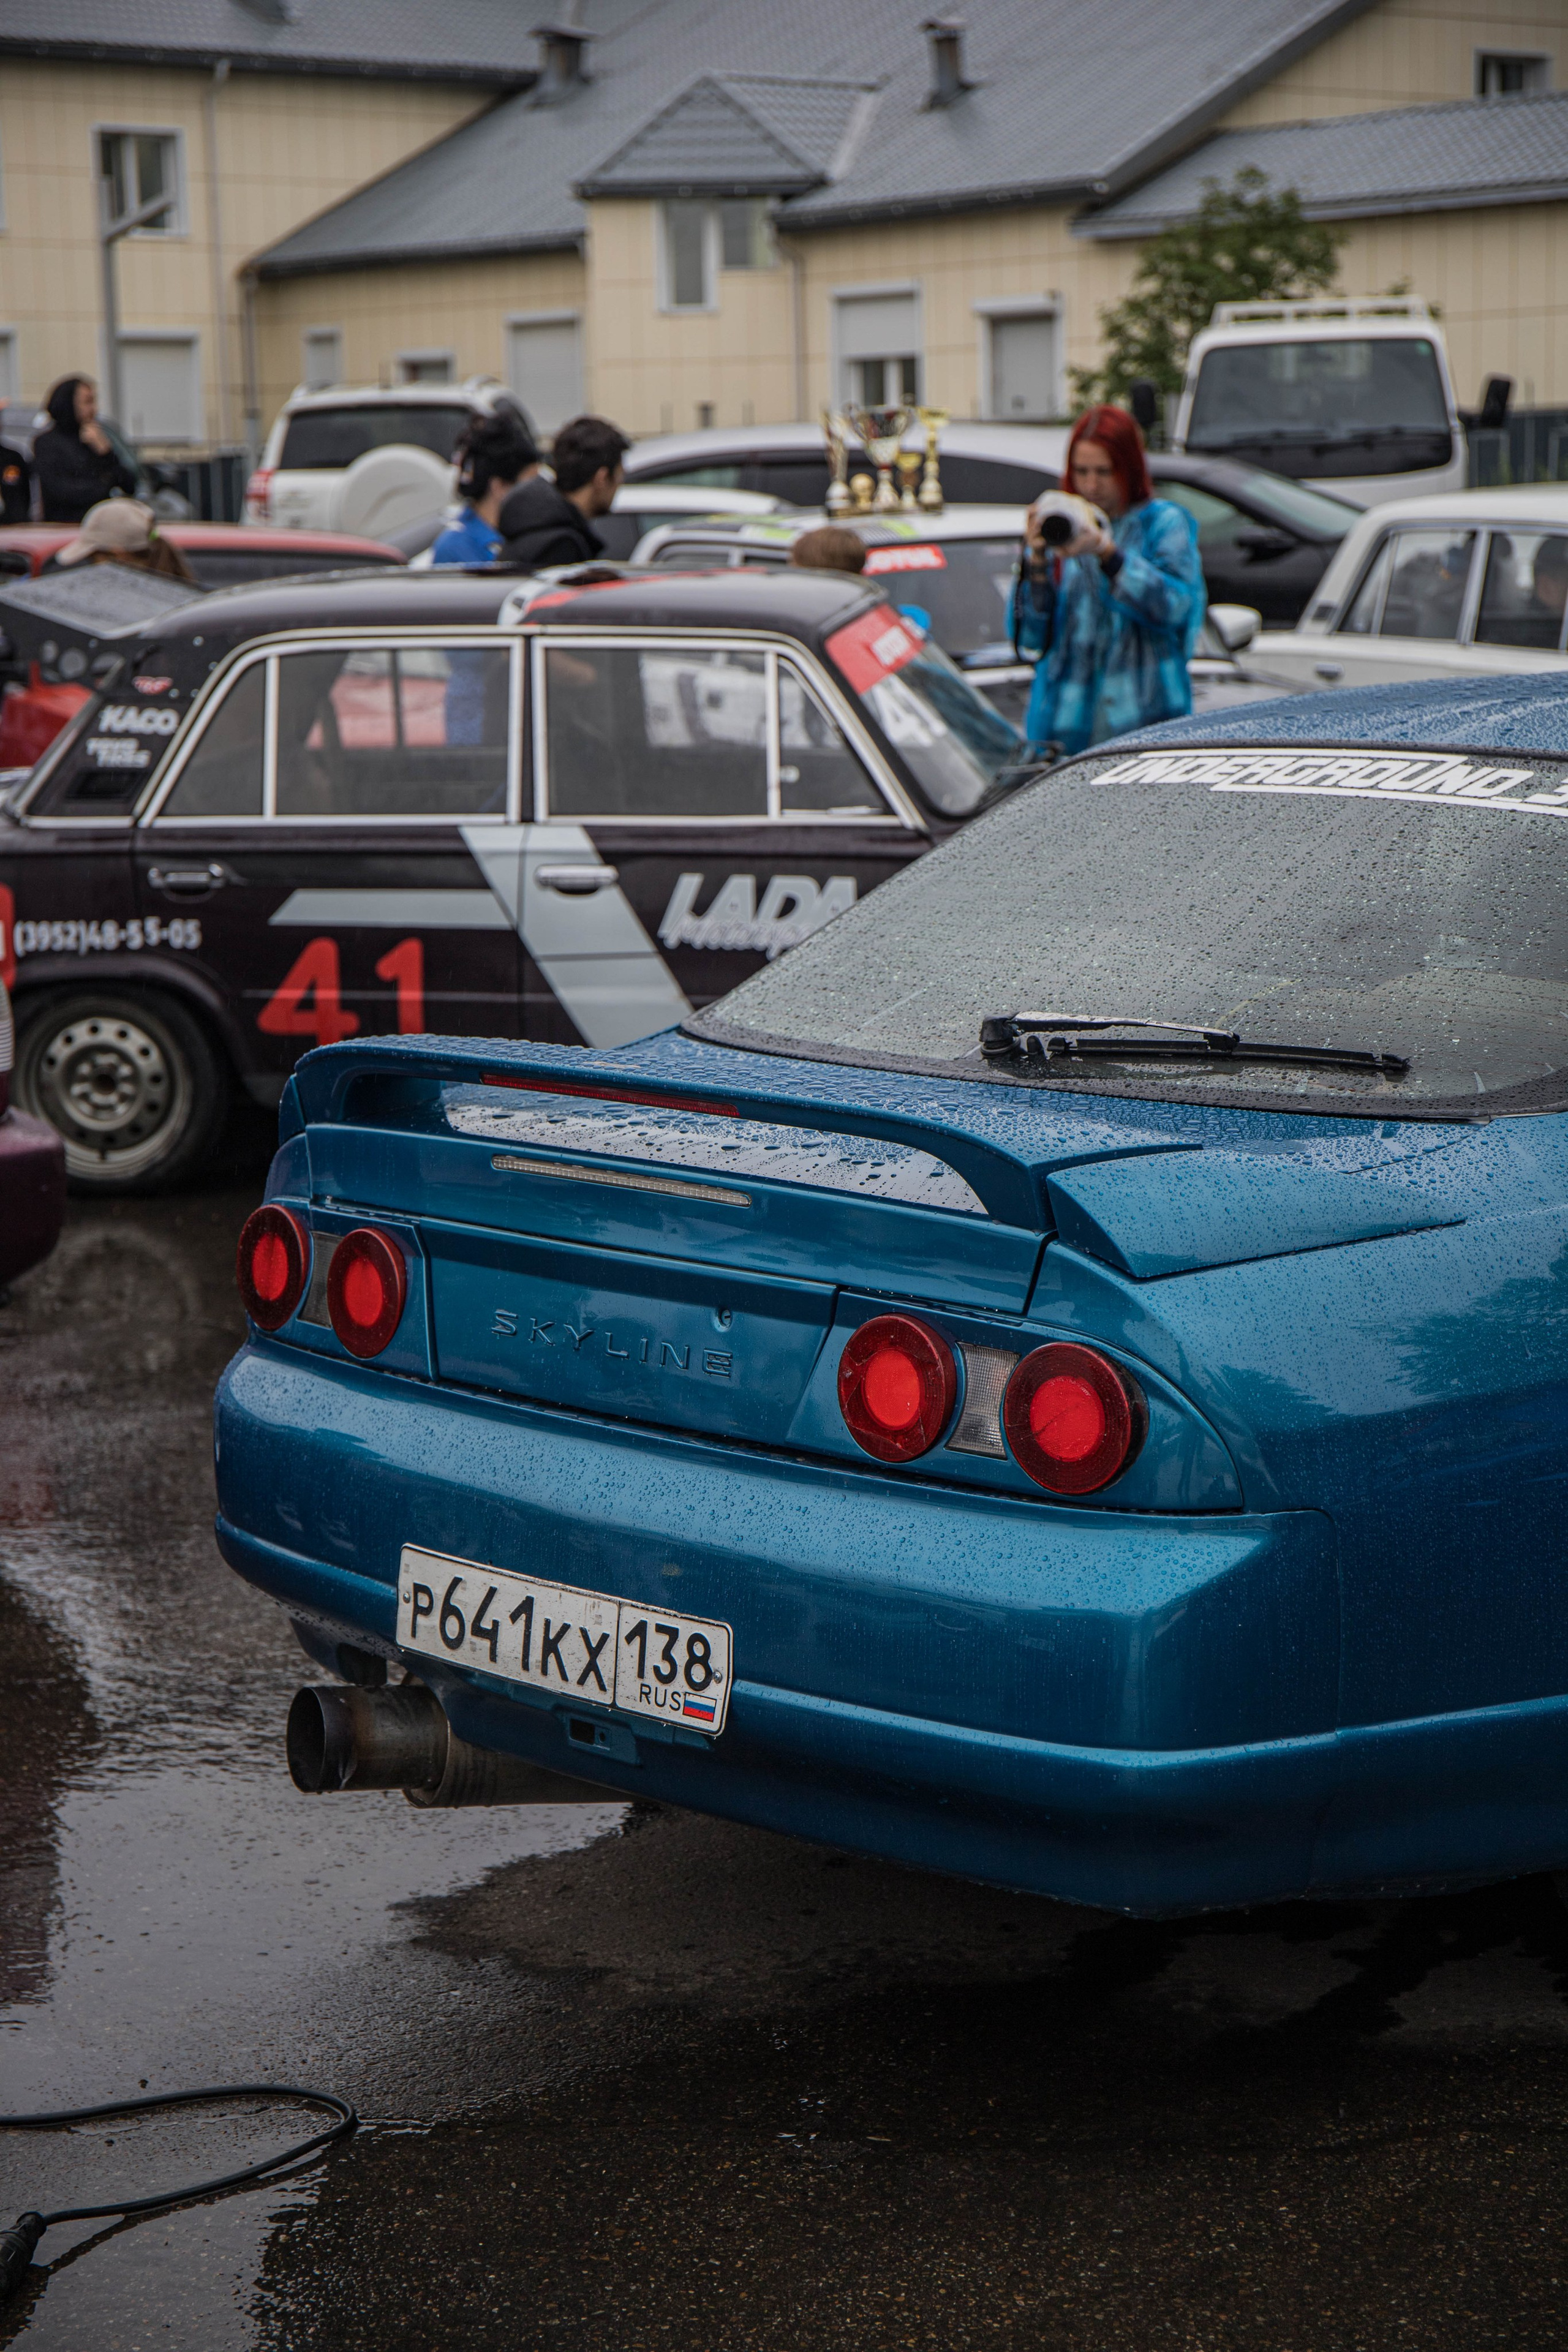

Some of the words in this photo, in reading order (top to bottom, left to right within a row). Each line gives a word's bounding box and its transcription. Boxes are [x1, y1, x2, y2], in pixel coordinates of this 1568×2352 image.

[864, 547, 941, 574] OTUL
[658, 873, 857, 937] LADA
[257, 937, 424, 1045] 41
[491, 1309, 733, 1378] SKYLINE
[624, 1619, 712, 1691] 138
[639, 1684, 681, 1711] RUS
